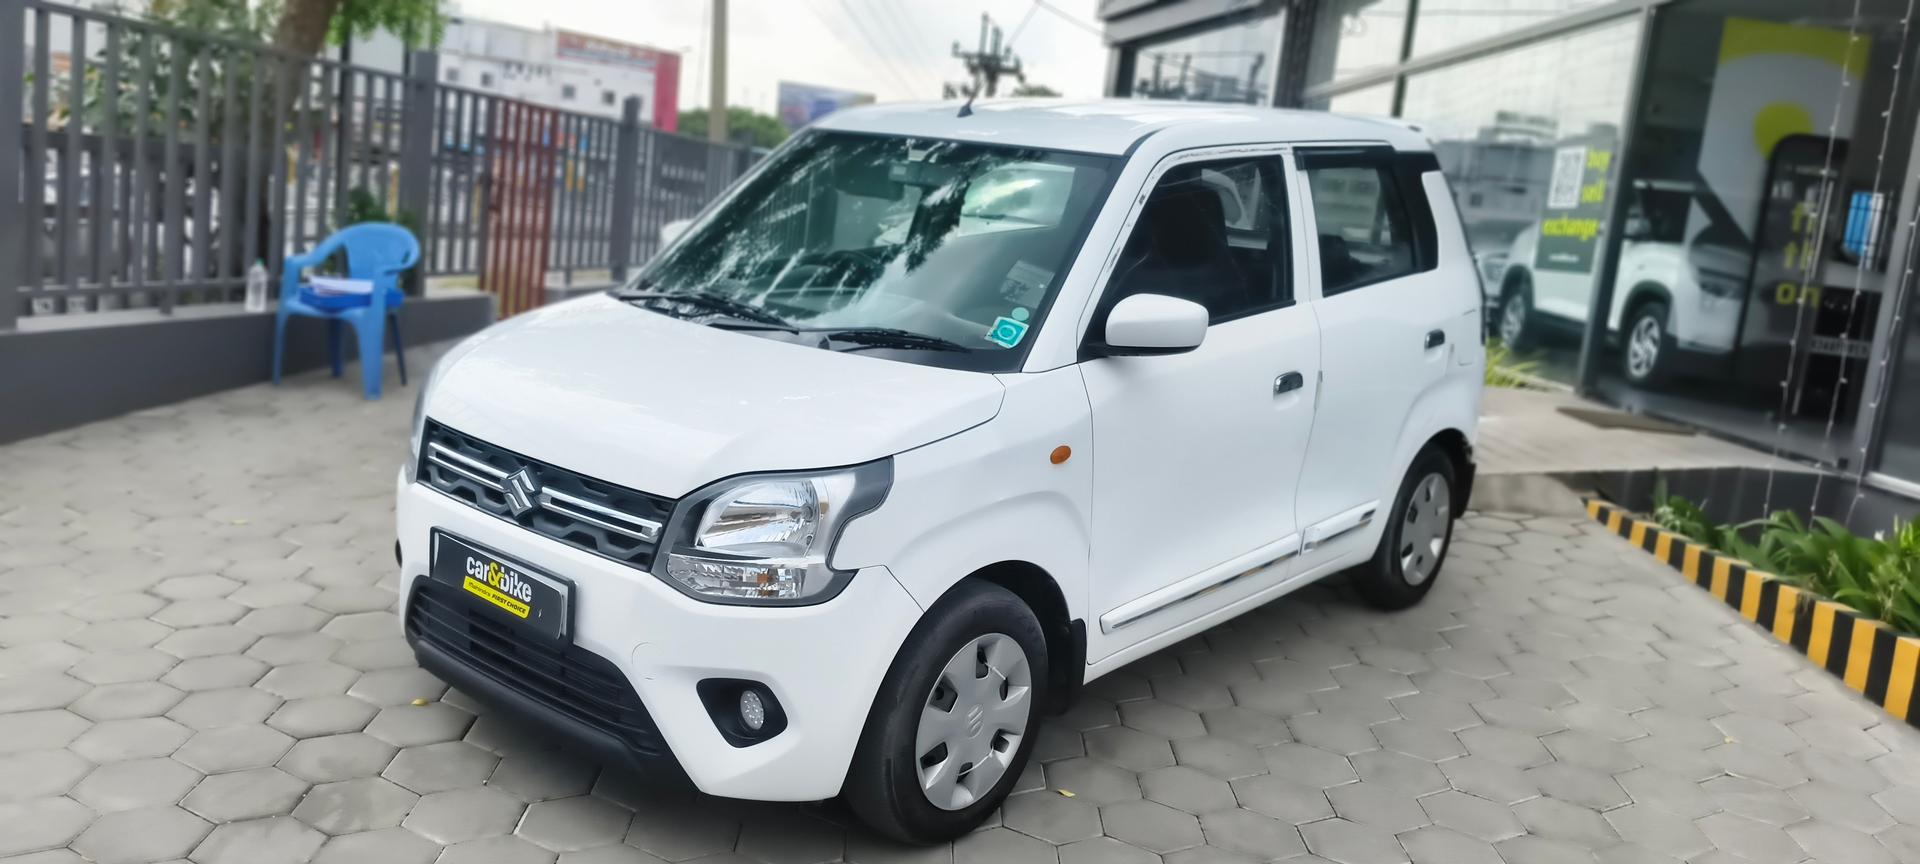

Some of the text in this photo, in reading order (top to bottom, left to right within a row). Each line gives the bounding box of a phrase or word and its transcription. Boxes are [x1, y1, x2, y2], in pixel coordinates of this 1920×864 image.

[1542, 213, 1598, 241] exchange
[466, 556, 532, 603] car&bike
[491, 594, 507, 605] FIRST
[506, 601, 526, 614] CHOICE
